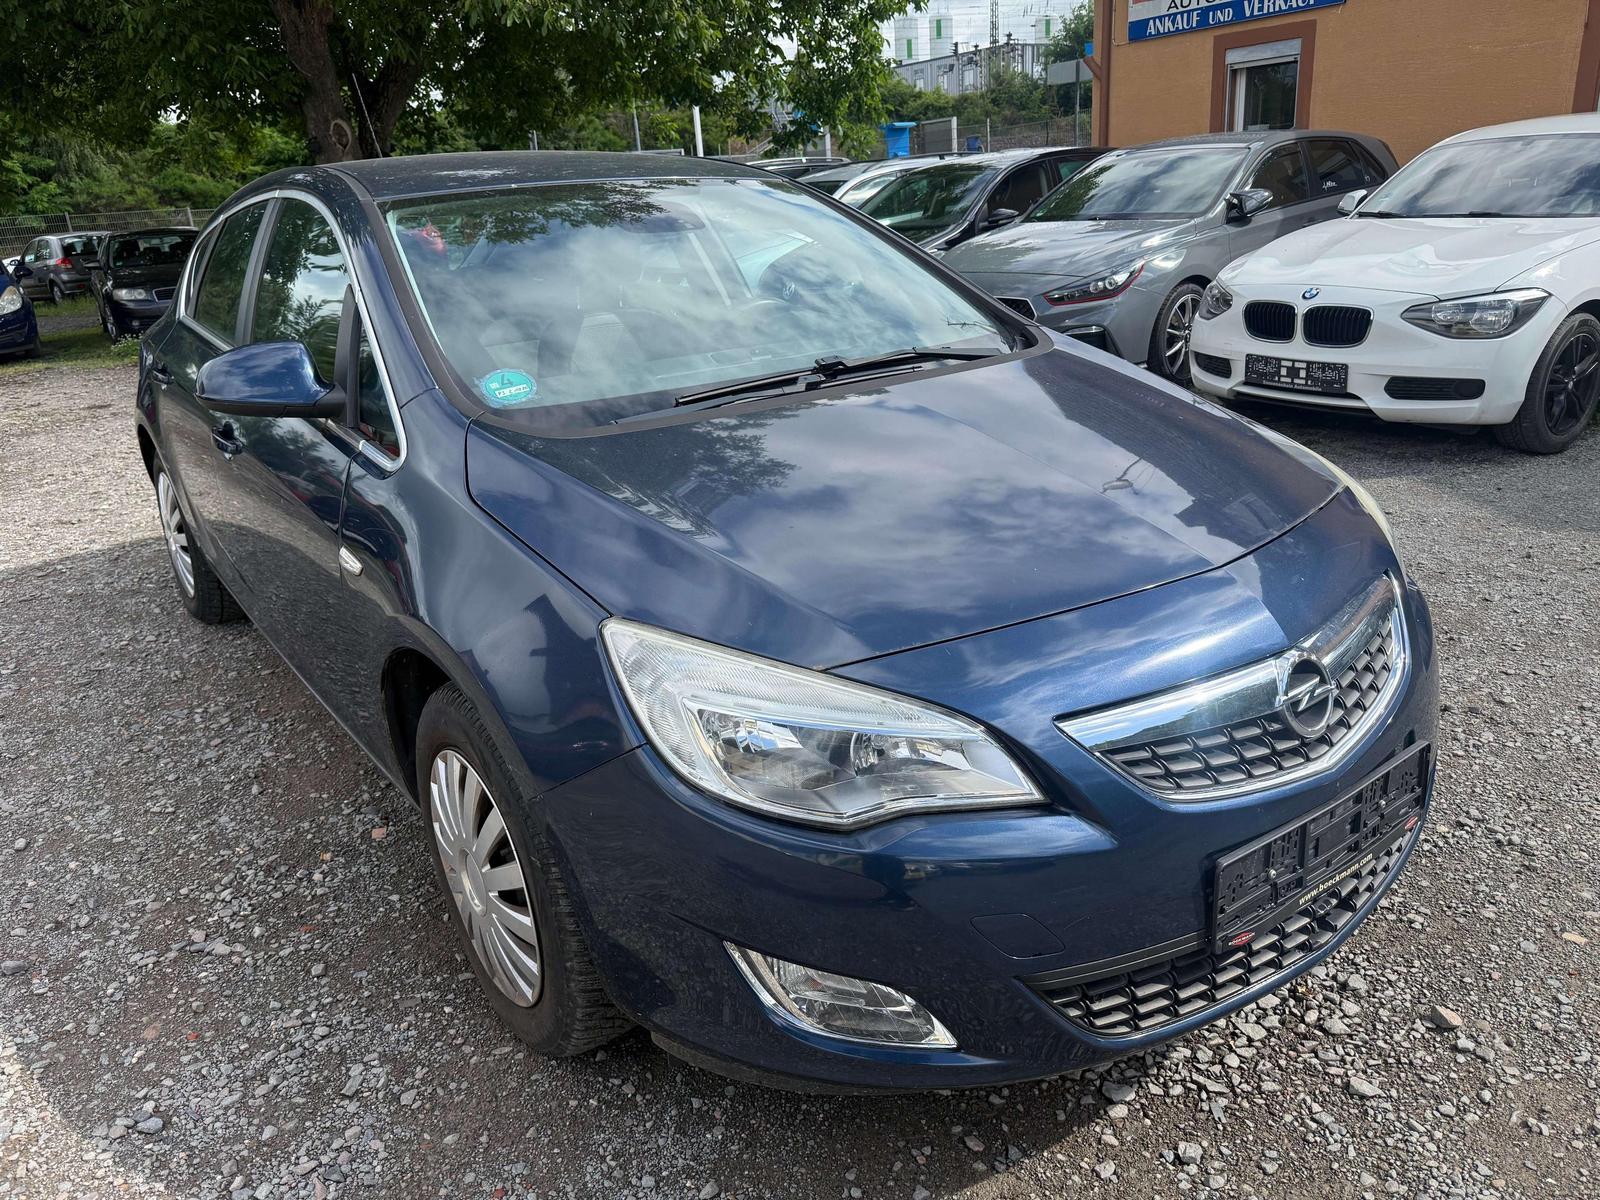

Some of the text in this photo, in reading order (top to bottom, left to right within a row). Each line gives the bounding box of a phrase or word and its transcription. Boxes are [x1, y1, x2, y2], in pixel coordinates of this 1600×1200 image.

[1146, 10, 1202, 36] ANKAUF
[1208, 7, 1233, 24] UND
[1299, 852, 1374, 905] www.boeckmann.com
